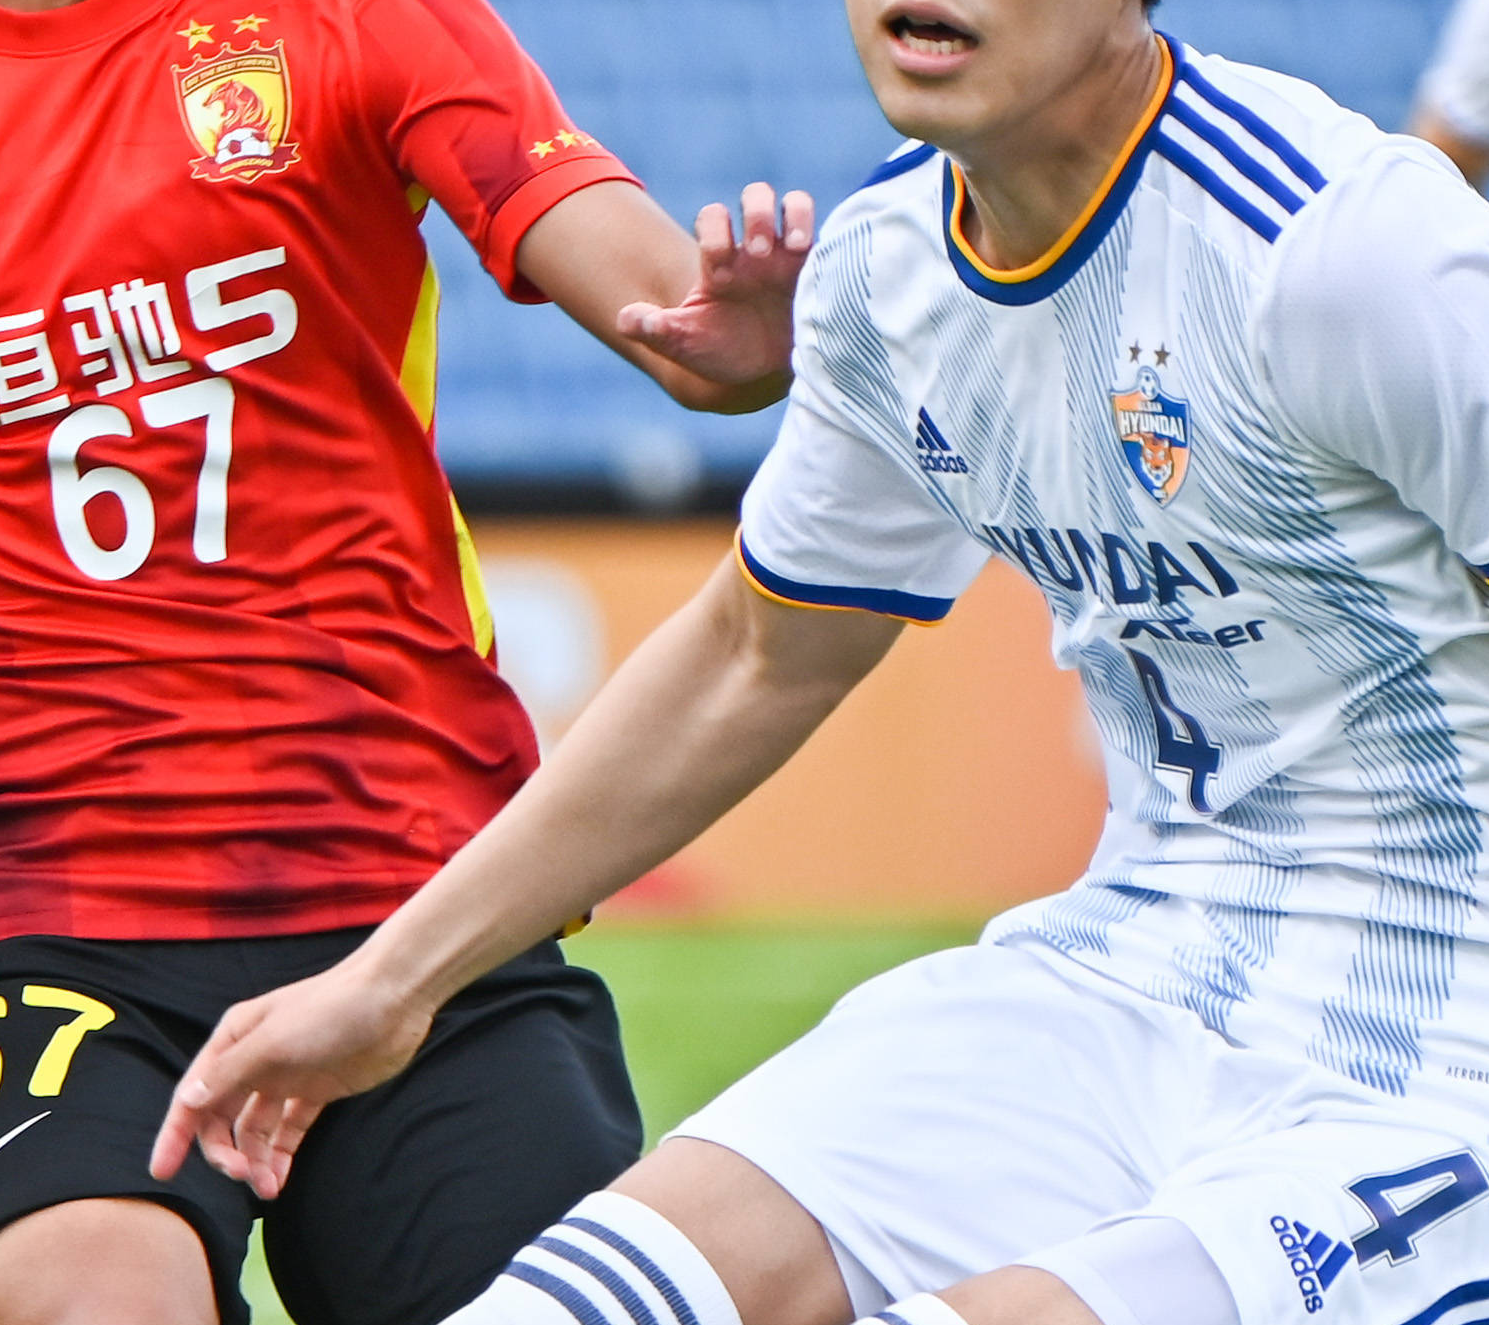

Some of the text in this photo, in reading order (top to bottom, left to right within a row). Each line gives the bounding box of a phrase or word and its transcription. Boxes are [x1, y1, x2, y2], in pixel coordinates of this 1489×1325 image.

[46, 375, 235, 581] 67
[1119, 408, 1188, 445] HYUNDAI
[1123, 642, 1224, 817] 4
[1270, 1215, 1324, 1314] adidas
